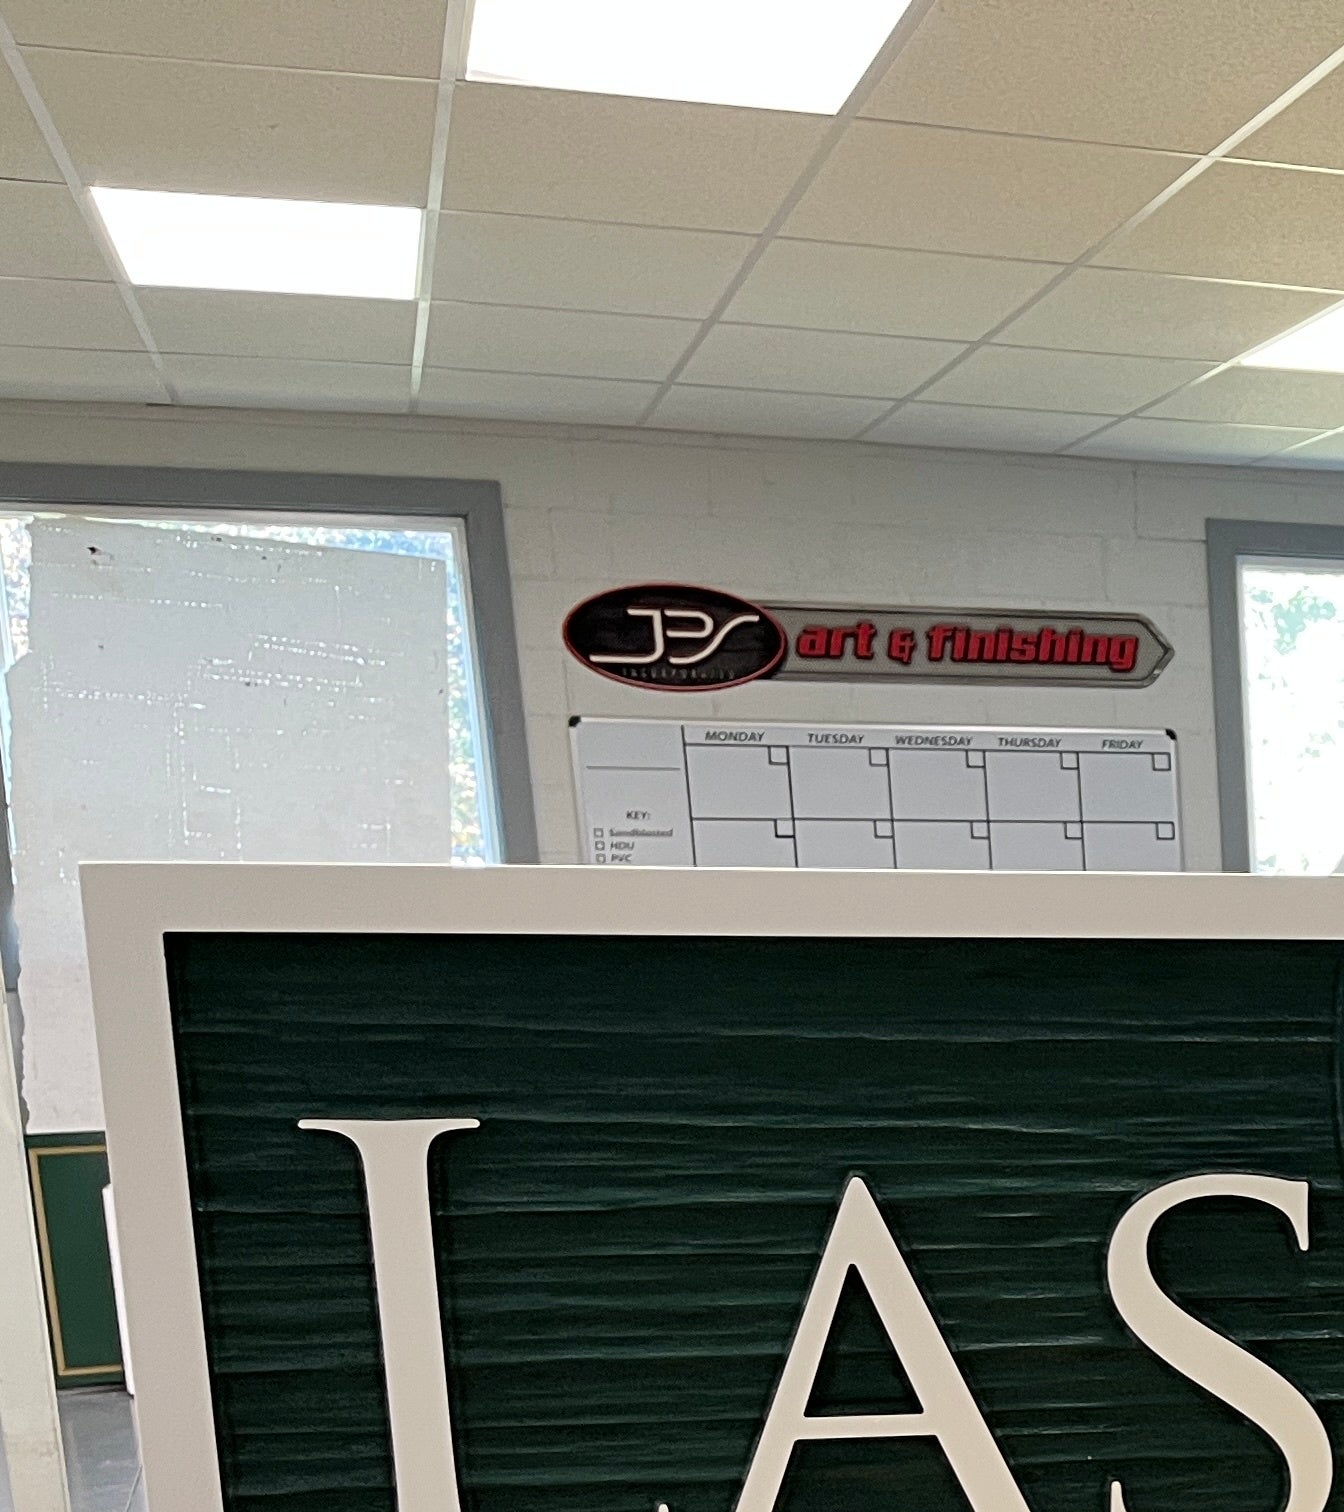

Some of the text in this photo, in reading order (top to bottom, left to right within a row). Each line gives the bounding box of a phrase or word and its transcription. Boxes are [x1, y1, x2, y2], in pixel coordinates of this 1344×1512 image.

[797, 621, 1139, 673] art & finishing
[704, 731, 1143, 750] MONDAY TUESDAY WEDNESDAY THURSDAY FRIDAY
[626, 810, 651, 820] KEY:
[611, 853, 632, 863] PVC
